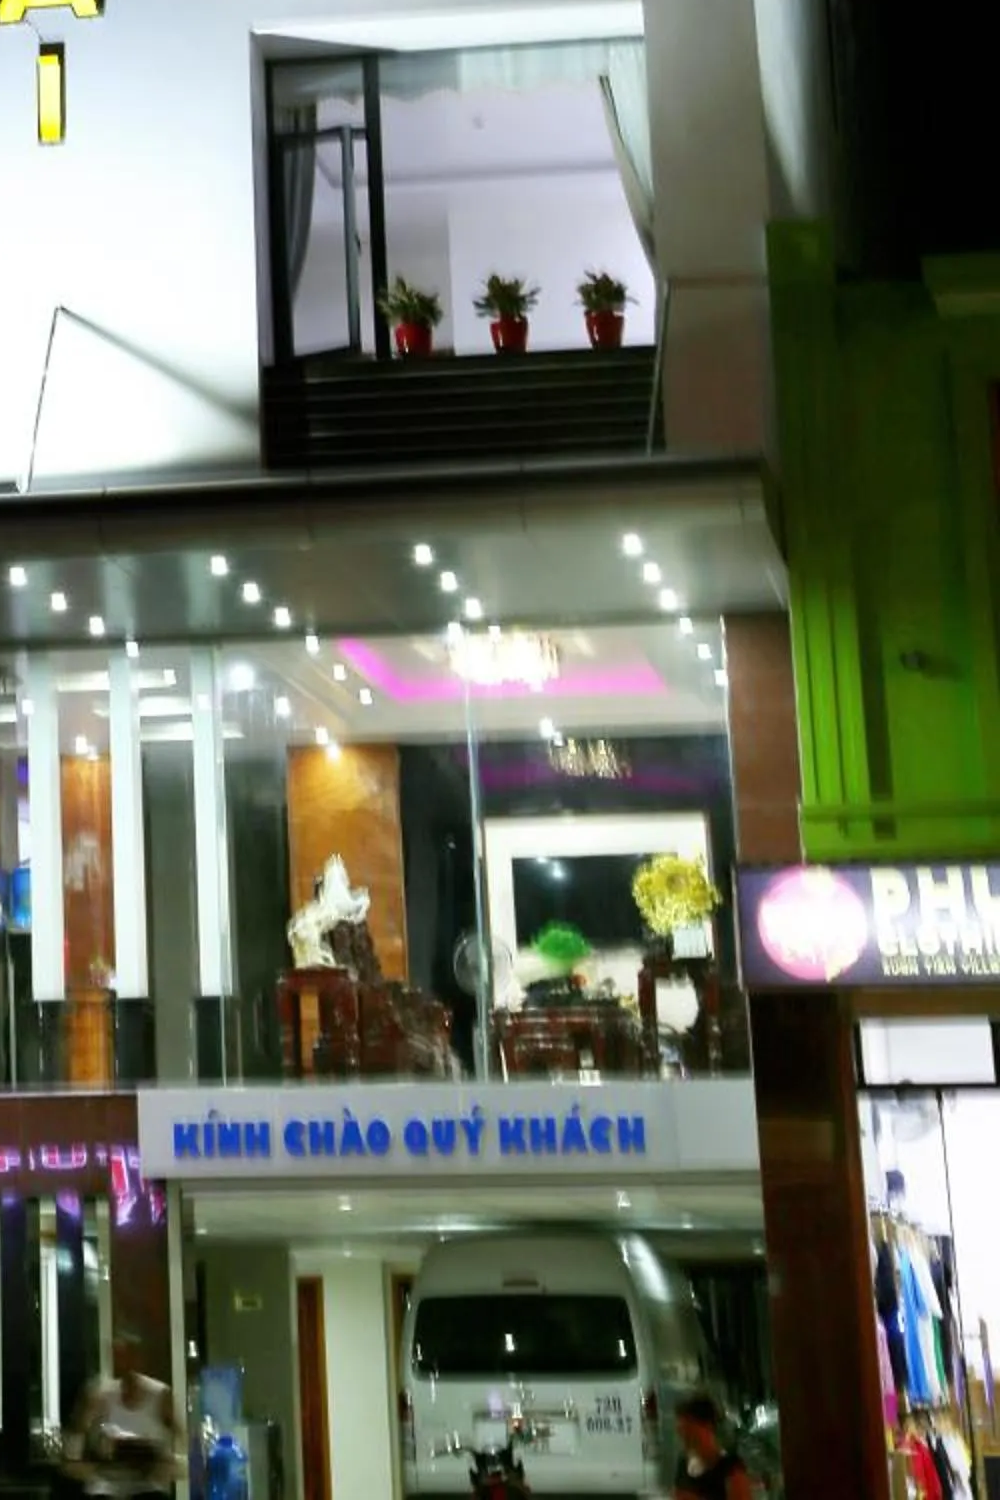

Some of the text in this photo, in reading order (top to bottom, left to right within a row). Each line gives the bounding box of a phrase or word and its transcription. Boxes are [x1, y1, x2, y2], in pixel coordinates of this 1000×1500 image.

[172, 1103, 647, 1158] KÍNH CHÀO QUÝ KHÁCH
